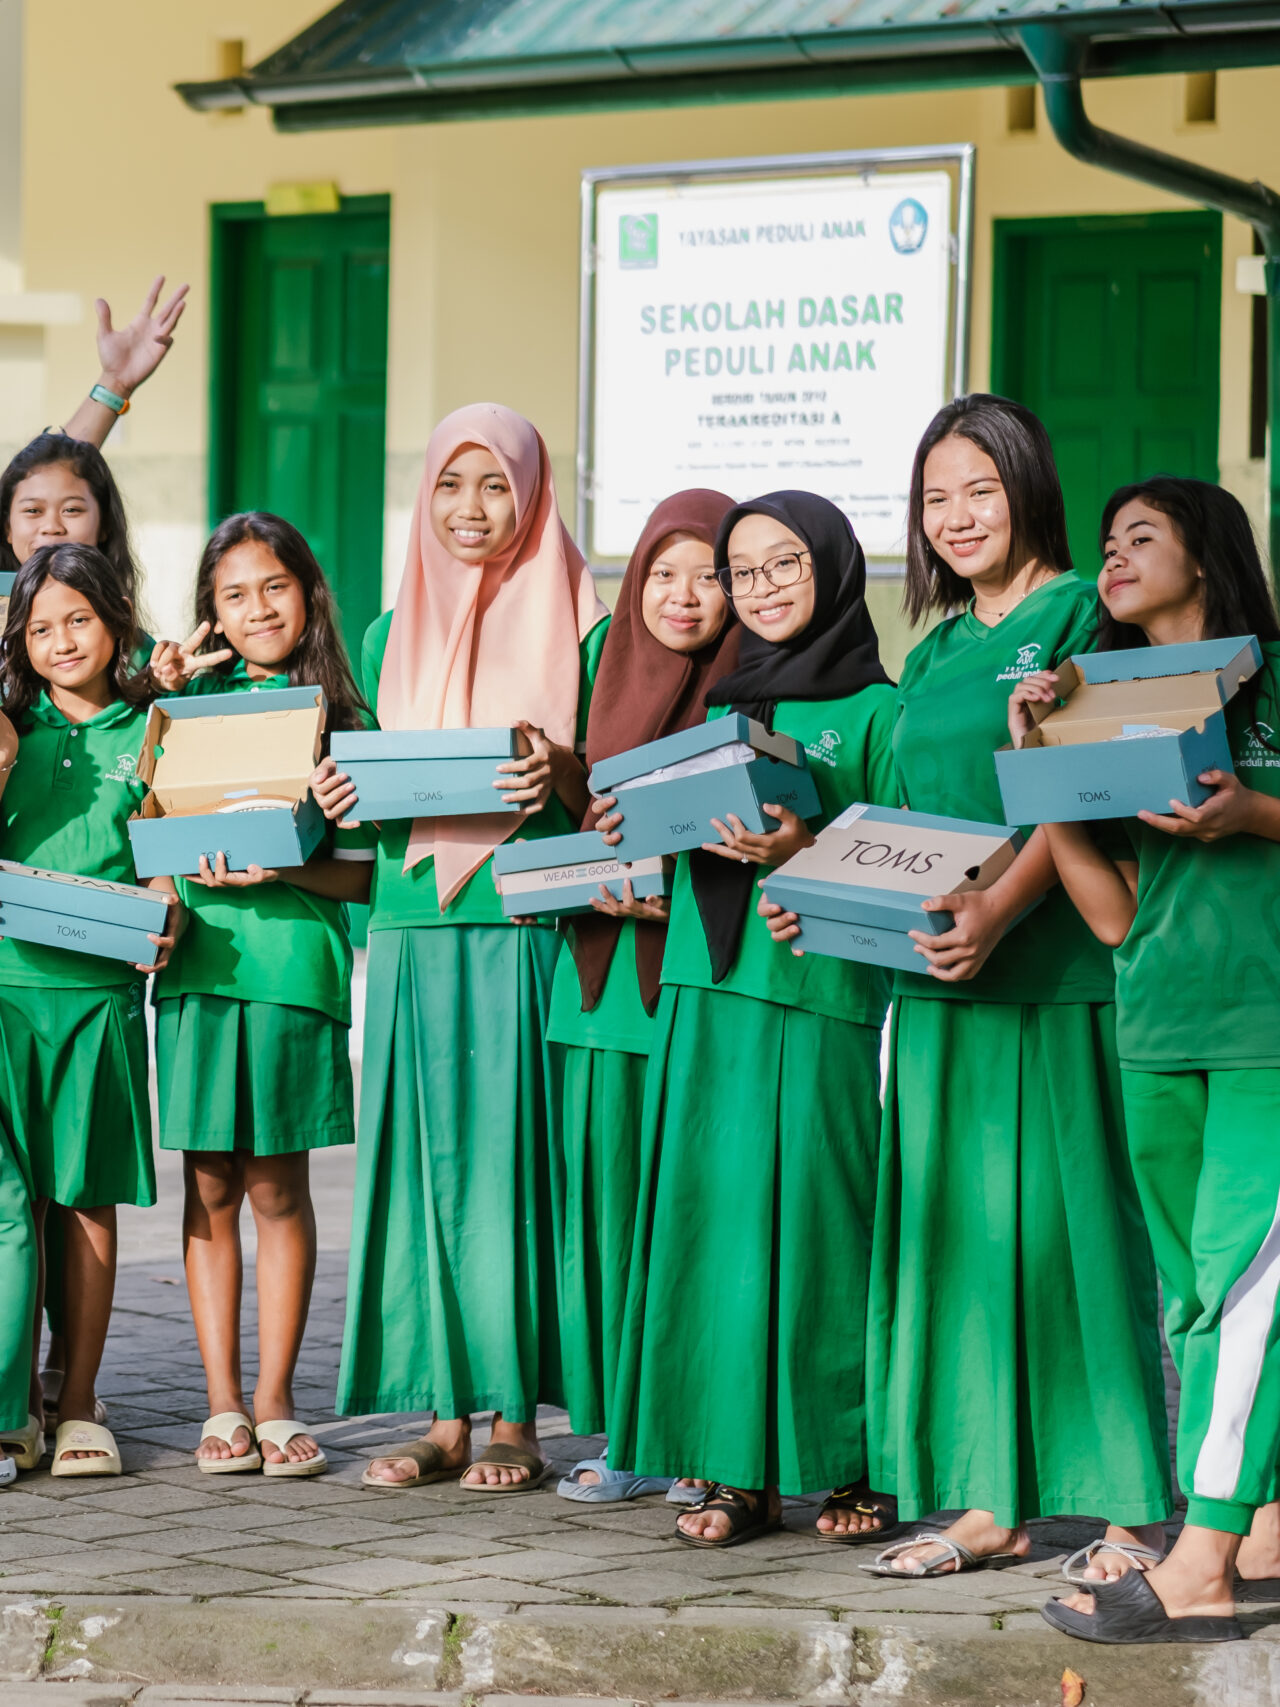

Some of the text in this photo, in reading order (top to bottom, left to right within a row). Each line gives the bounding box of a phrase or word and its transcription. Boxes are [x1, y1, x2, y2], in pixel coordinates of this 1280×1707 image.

[679, 219, 866, 247] YAYASAN PEDULI ANAK
[641, 292, 904, 335] SEKOLAH DASAR
[665, 339, 877, 377] PEDULI ANAK
[995, 671, 1022, 682] peduli
[1234, 757, 1280, 768] peduli ana
[412, 790, 443, 803] TOMS
[1077, 790, 1111, 803] TOMS
[670, 821, 697, 836] TOMS
[840, 840, 943, 874] TOMS
[543, 863, 620, 882] WEAR GOOD
[56, 925, 87, 940] TOMS
[850, 934, 878, 948] TOMS
